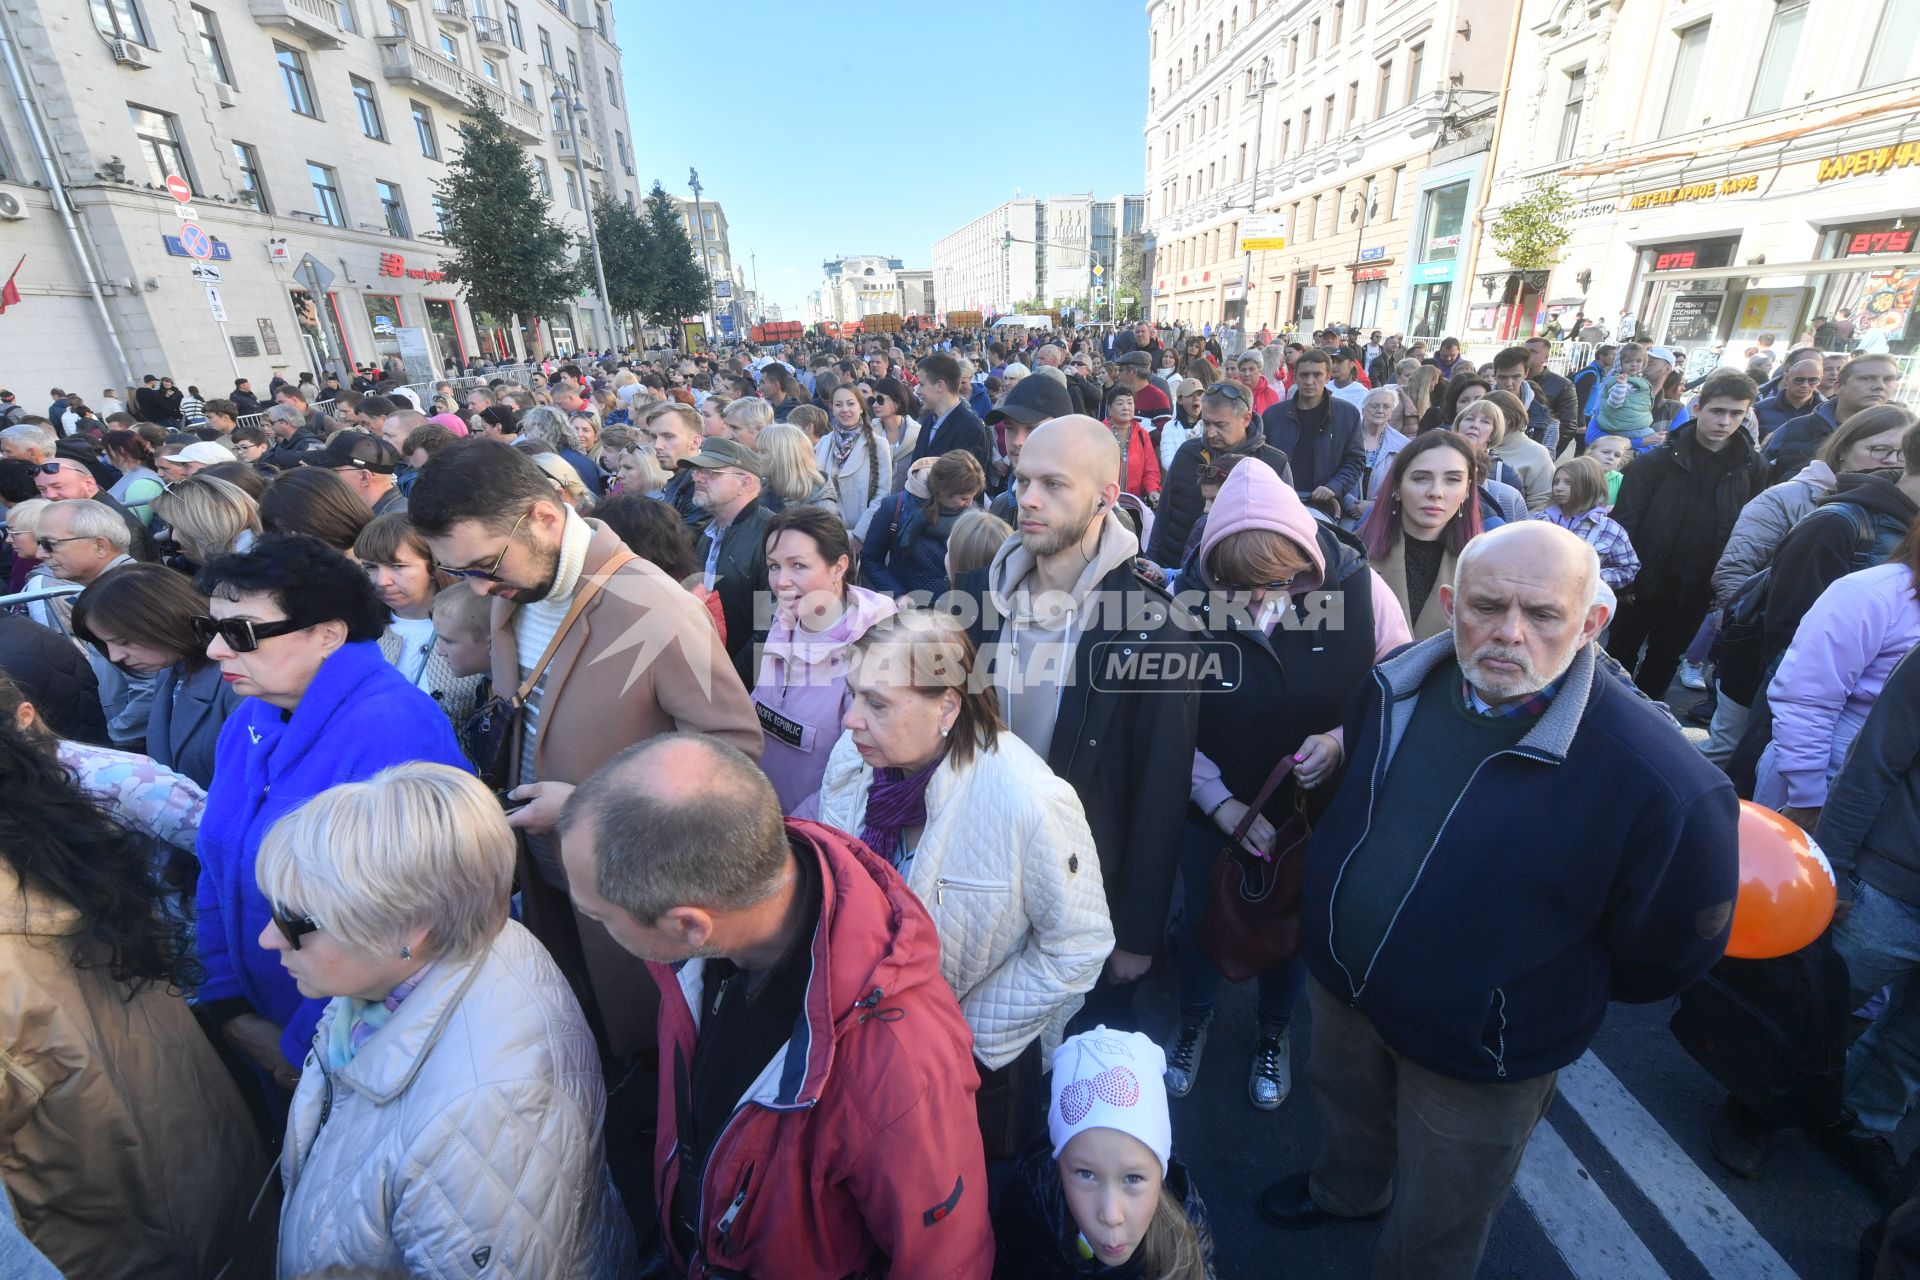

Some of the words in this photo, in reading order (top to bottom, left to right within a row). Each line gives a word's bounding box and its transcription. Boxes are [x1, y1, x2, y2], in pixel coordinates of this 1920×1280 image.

[1630, 182, 1717, 209] ЛЕГЕНДАРНОЕ
[1720, 174, 1759, 195] КАФЕ
[216, 246, 227, 256] 17
[1849, 230, 1912, 253] 875
[1656, 252, 1696, 269] 875
[774, 715, 801, 737] REPUBLIC
